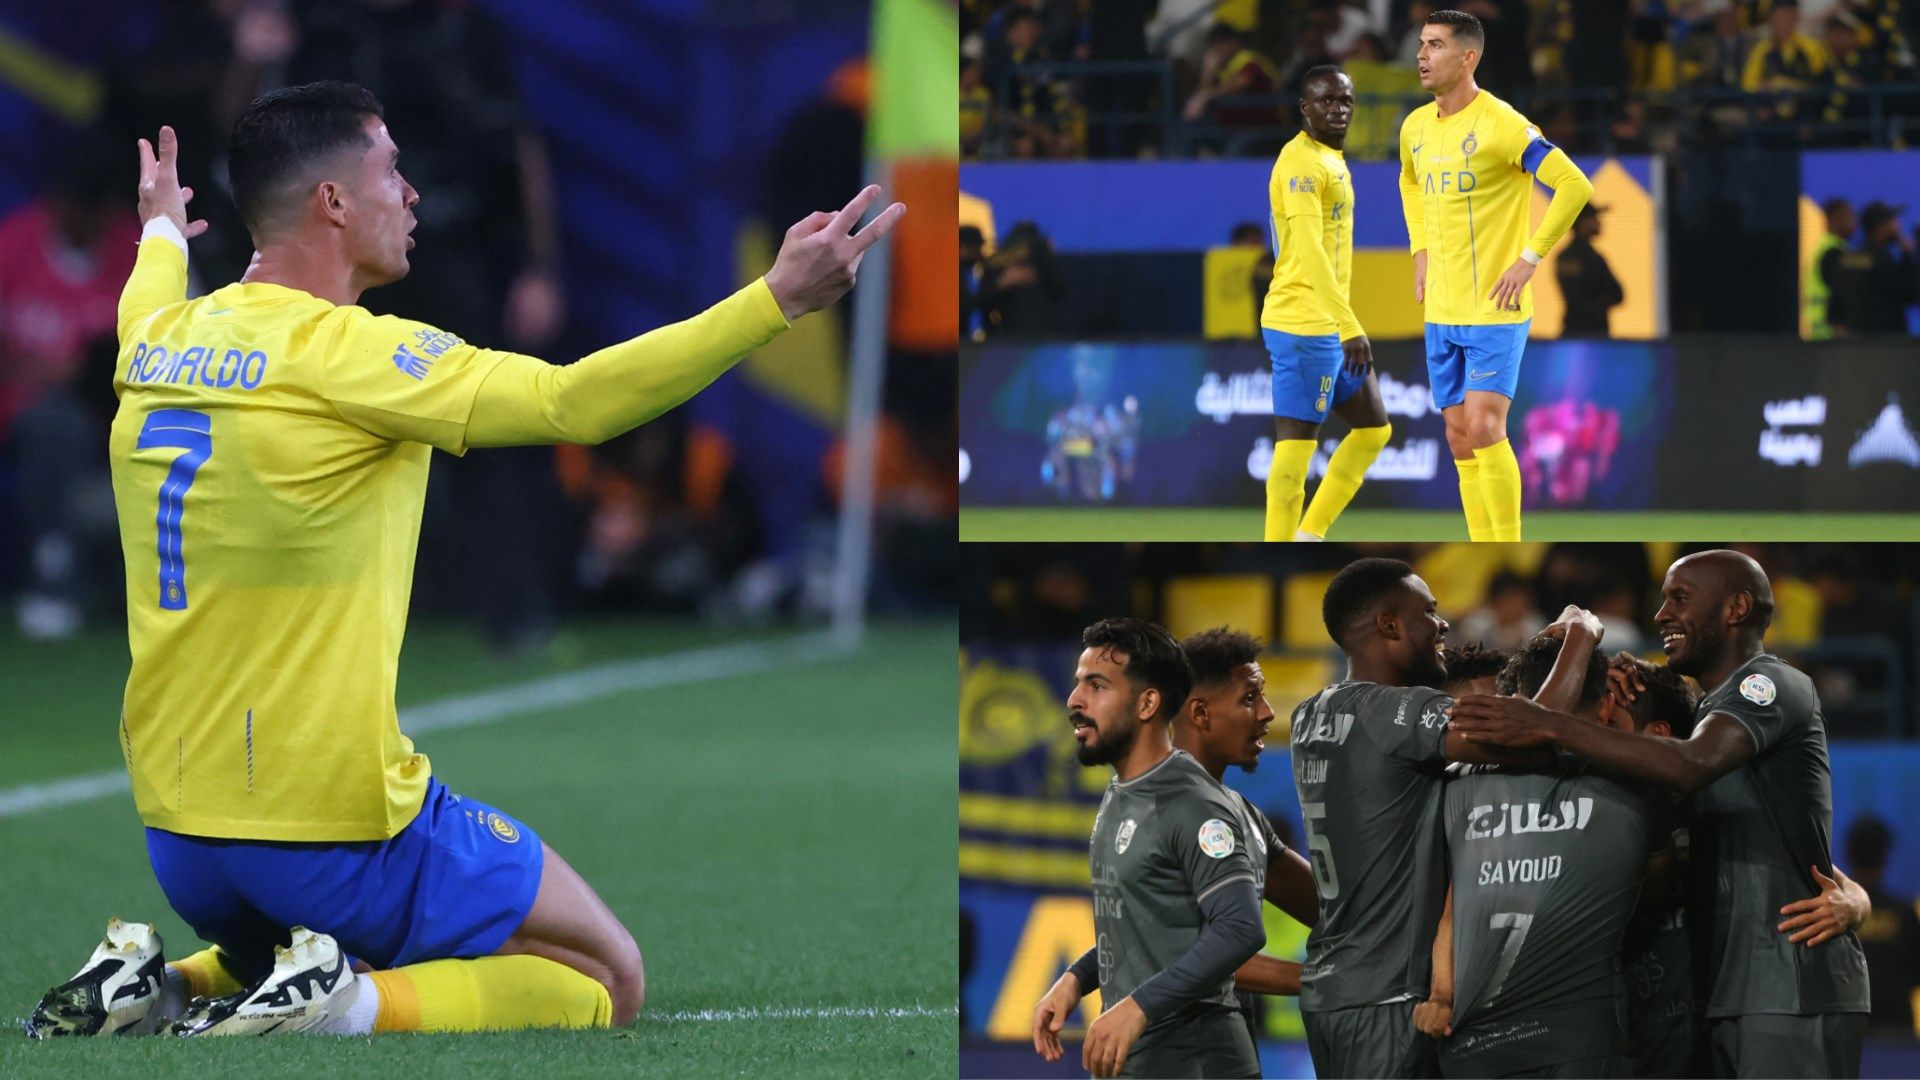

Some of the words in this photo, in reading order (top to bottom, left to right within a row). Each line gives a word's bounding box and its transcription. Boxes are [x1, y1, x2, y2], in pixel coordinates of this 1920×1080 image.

[1418, 171, 1477, 194] AFD
[125, 342, 267, 390] RONALDO
[1319, 376, 1332, 393] 10
[136, 408, 213, 611] 7
[1301, 759, 1329, 784] LOUM
[1464, 797, 1594, 841] الطازج
[1303, 802, 1340, 900] 5
[1478, 855, 1562, 886] SAYOUD
[1485, 912, 1535, 1008] 7
